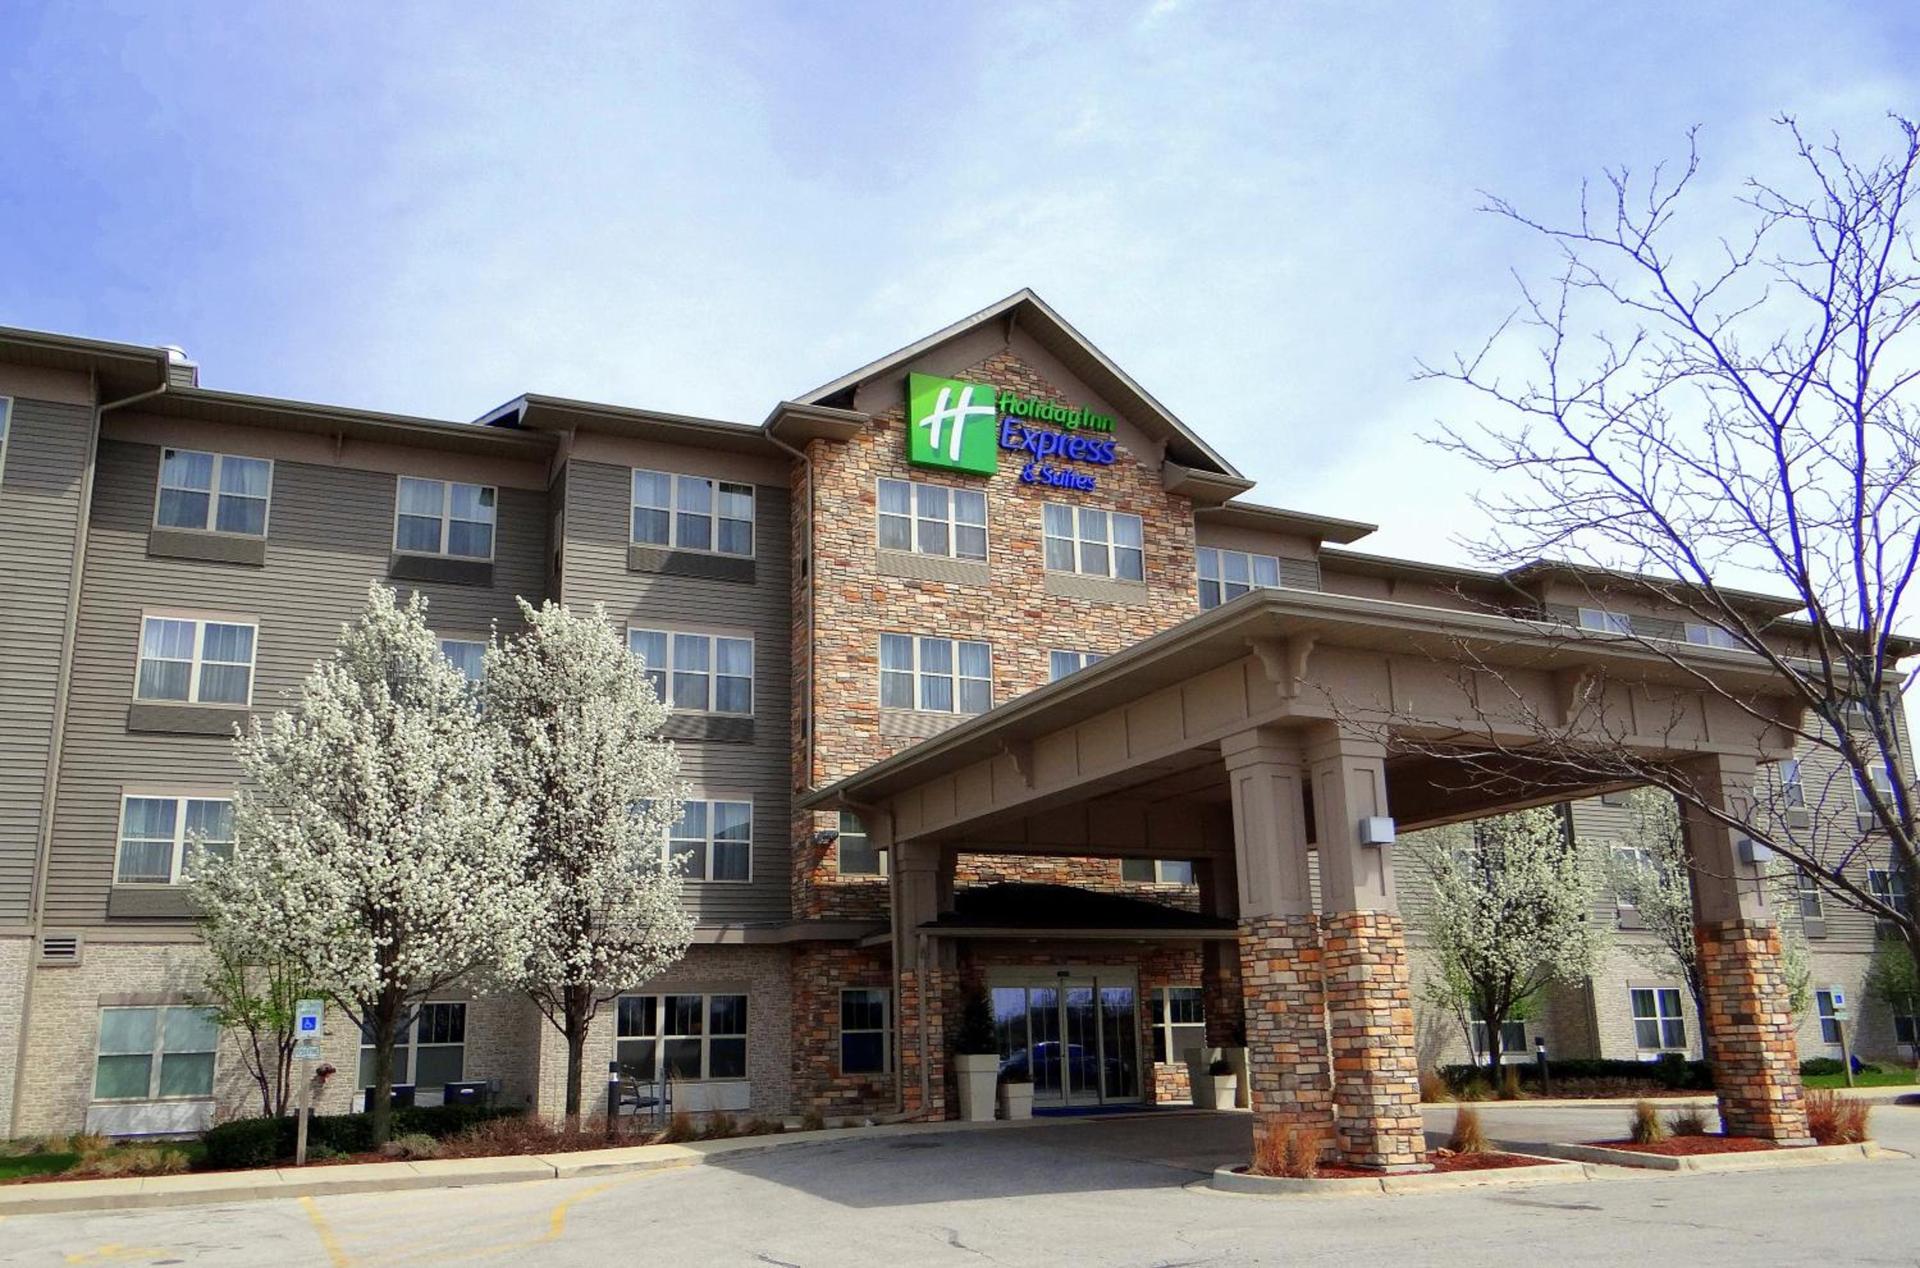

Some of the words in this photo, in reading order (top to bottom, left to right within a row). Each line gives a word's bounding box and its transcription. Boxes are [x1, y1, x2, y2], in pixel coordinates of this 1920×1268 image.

[919, 386, 996, 461] H
[999, 391, 1080, 430] Holiday
[1081, 406, 1116, 432] Inn
[999, 416, 1117, 464] Express
[1021, 462, 1037, 483] &
[1039, 465, 1097, 492] Suites
